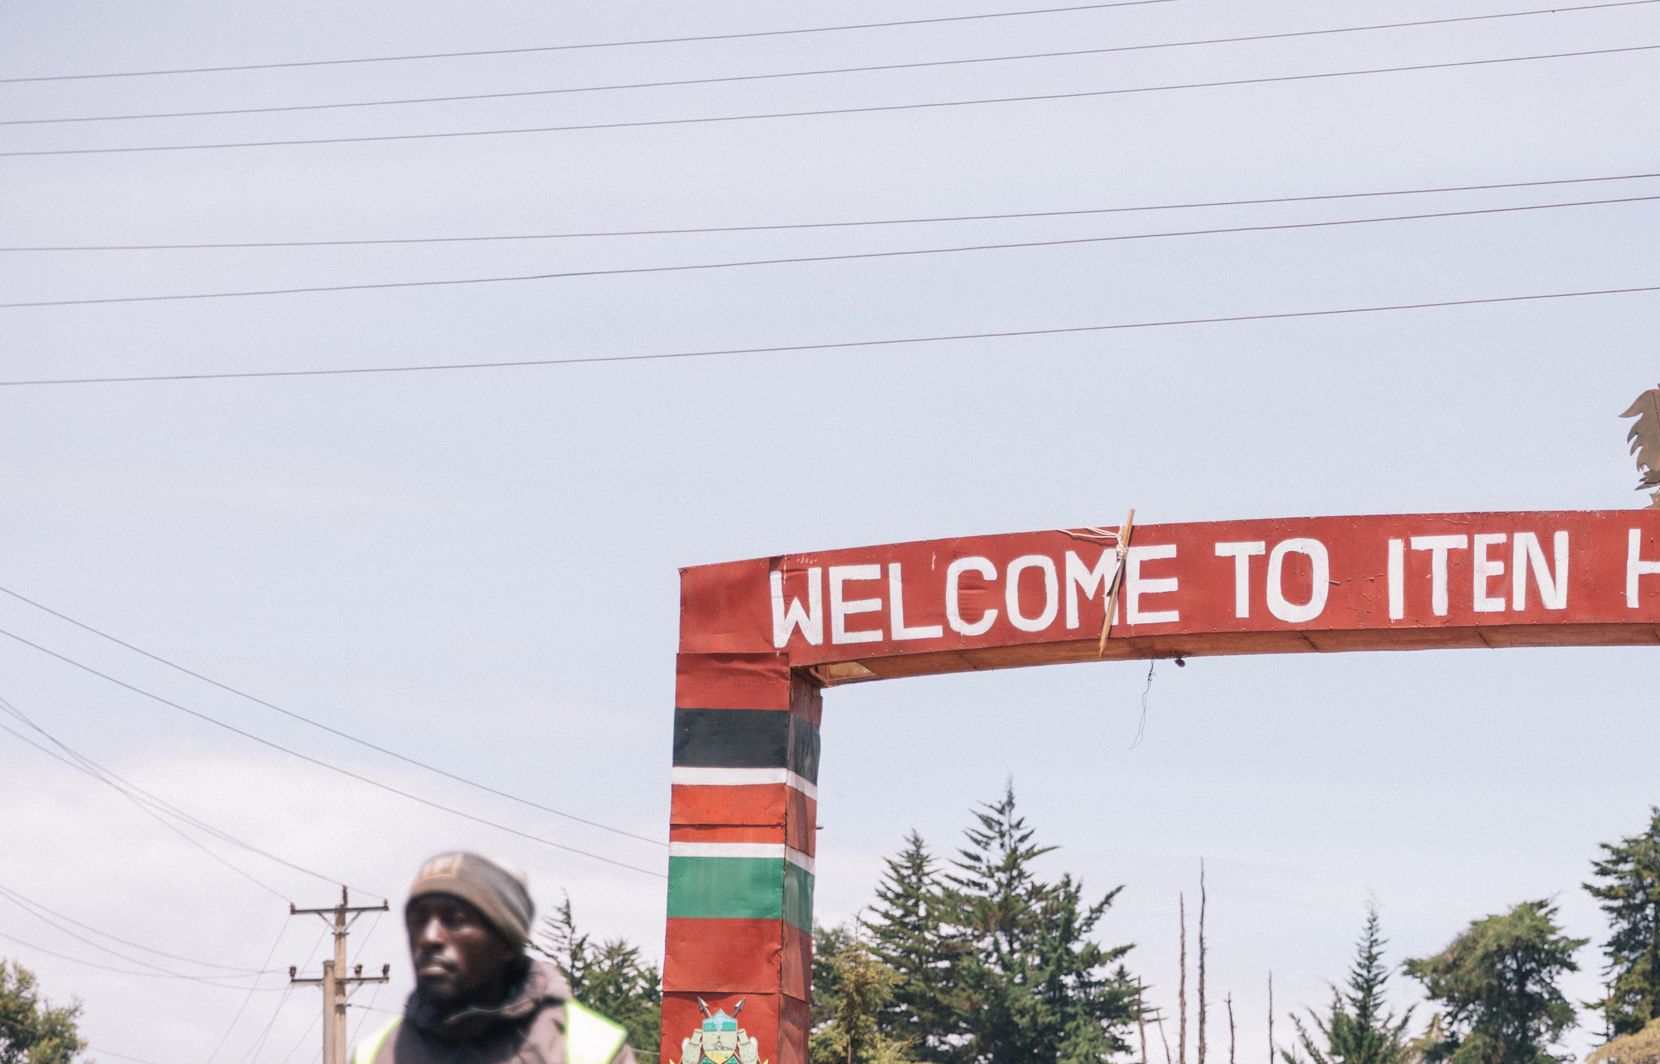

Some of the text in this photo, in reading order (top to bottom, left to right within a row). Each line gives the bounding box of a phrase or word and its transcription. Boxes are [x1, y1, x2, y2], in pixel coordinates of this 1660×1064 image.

[770, 544, 1180, 649] WELCOME
[1214, 537, 1330, 624] TO
[1387, 530, 1570, 620] ITEN
